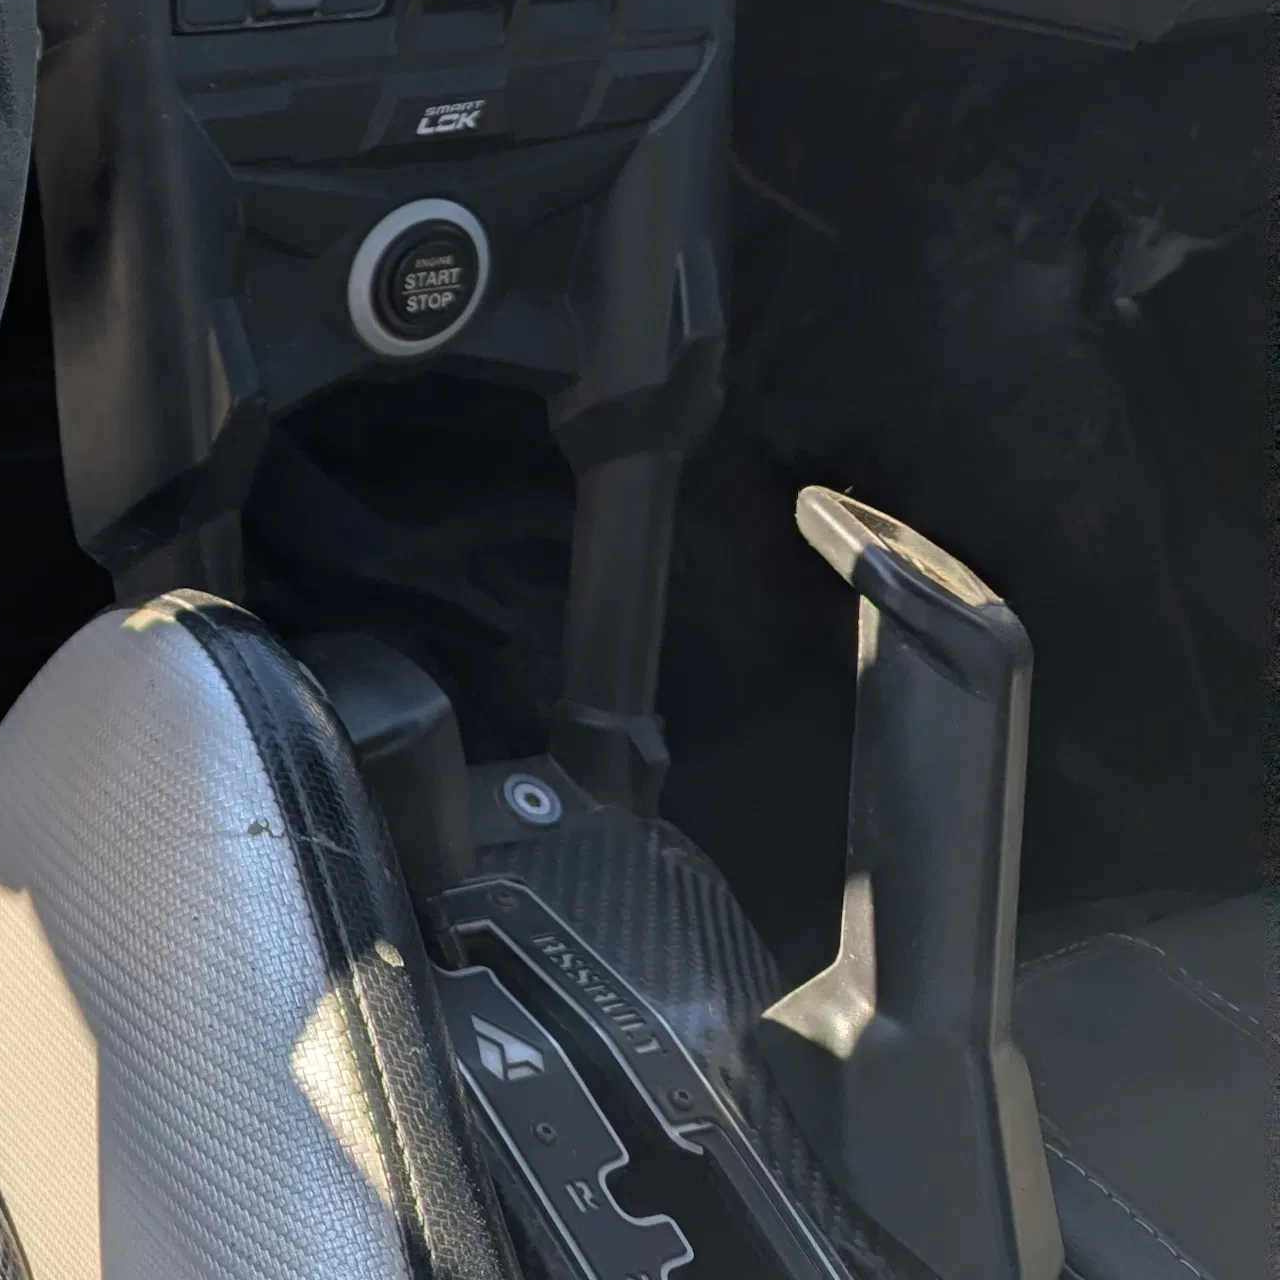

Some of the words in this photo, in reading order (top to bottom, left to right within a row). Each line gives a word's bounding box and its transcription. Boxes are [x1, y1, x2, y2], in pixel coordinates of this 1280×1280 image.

[424, 99, 486, 117] SMART
[416, 110, 481, 135] LOK
[404, 268, 463, 290] START
[406, 292, 455, 314] STOP
[564, 1180, 600, 1213] R
